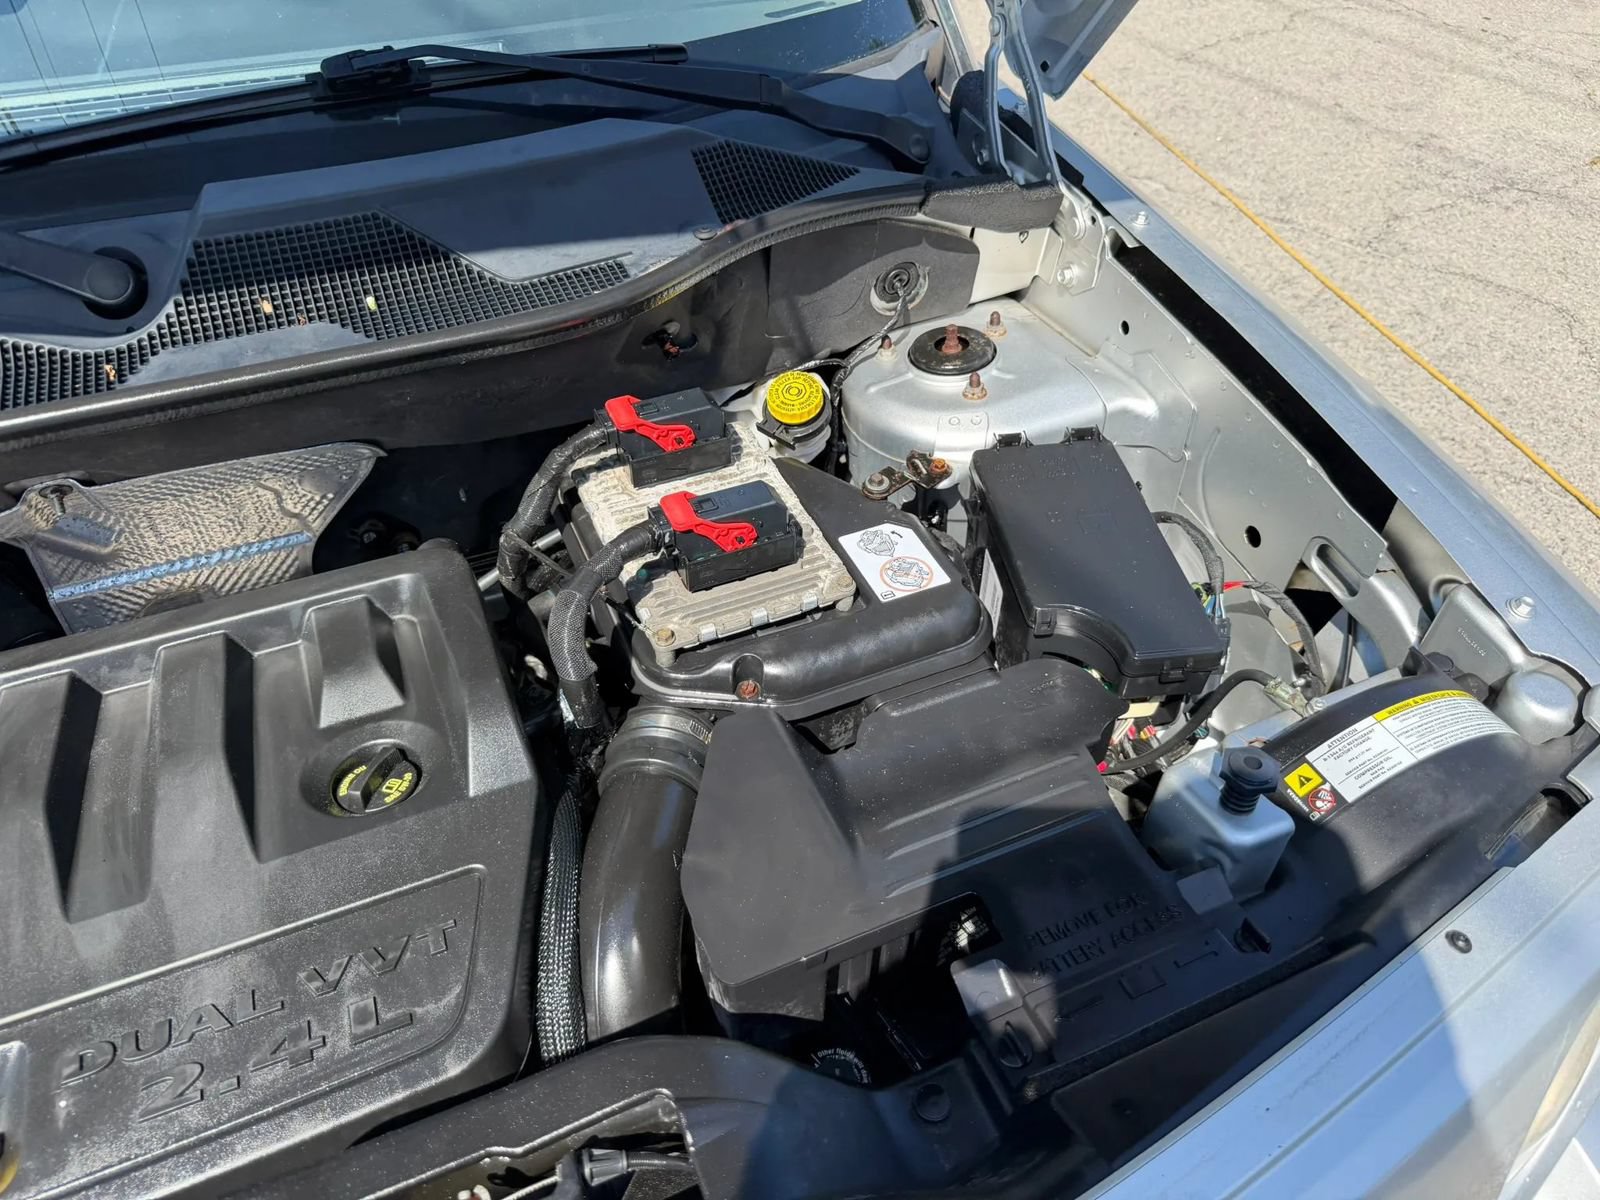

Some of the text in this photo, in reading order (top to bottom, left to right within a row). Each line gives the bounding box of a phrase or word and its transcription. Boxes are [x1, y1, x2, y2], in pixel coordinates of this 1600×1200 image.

[1326, 727, 1358, 749] ATTENTION
[1333, 747, 1354, 760] FACTORY
[1346, 728, 1375, 746] REFRIGERANT
[1354, 760, 1384, 780] COMPRESSOR
[1024, 910, 1102, 950] REMOVE
[1103, 893, 1148, 919] FOR
[1109, 903, 1185, 948] ACCESS
[60, 919, 457, 1088] DUAL VVT
[138, 996, 414, 1124] 2.4L
